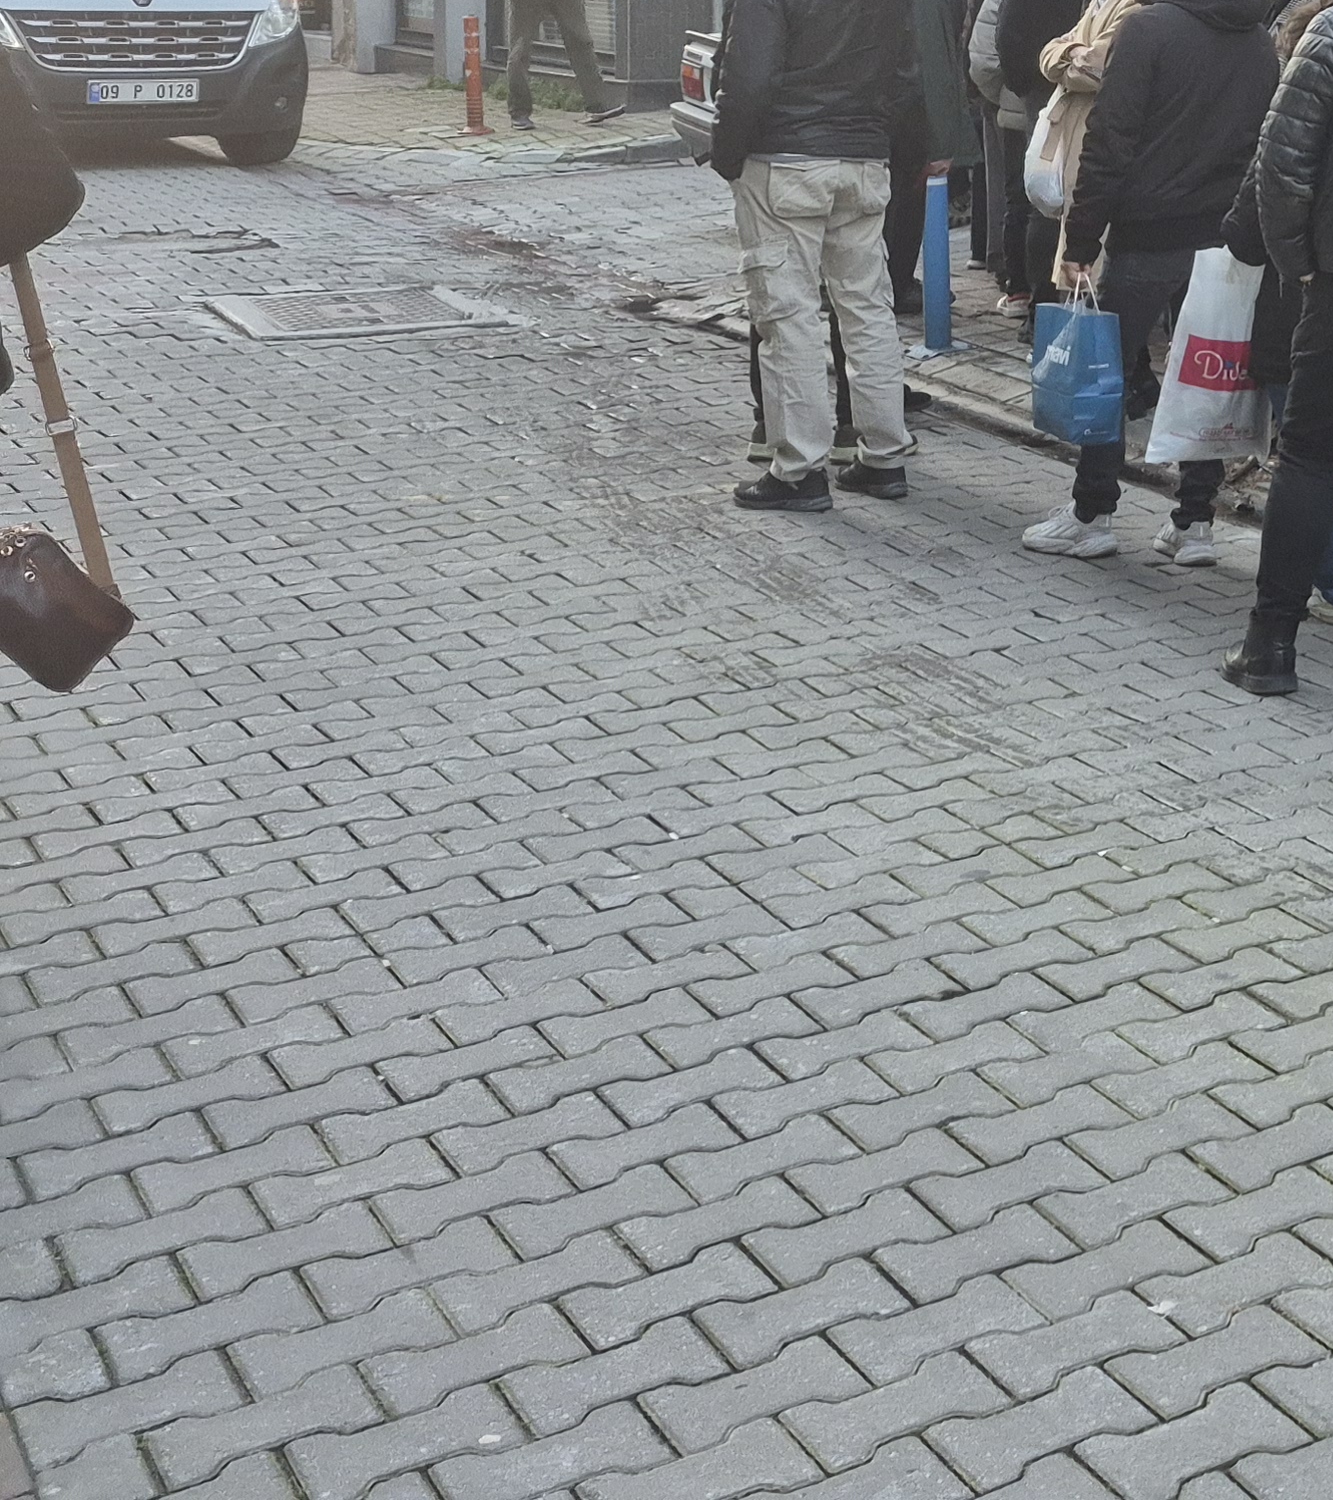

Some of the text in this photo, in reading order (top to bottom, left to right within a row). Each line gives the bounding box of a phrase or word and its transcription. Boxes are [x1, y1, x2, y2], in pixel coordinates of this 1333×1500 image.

[100, 84, 119, 100] 09
[133, 84, 143, 100] P
[156, 83, 195, 100] 0128
